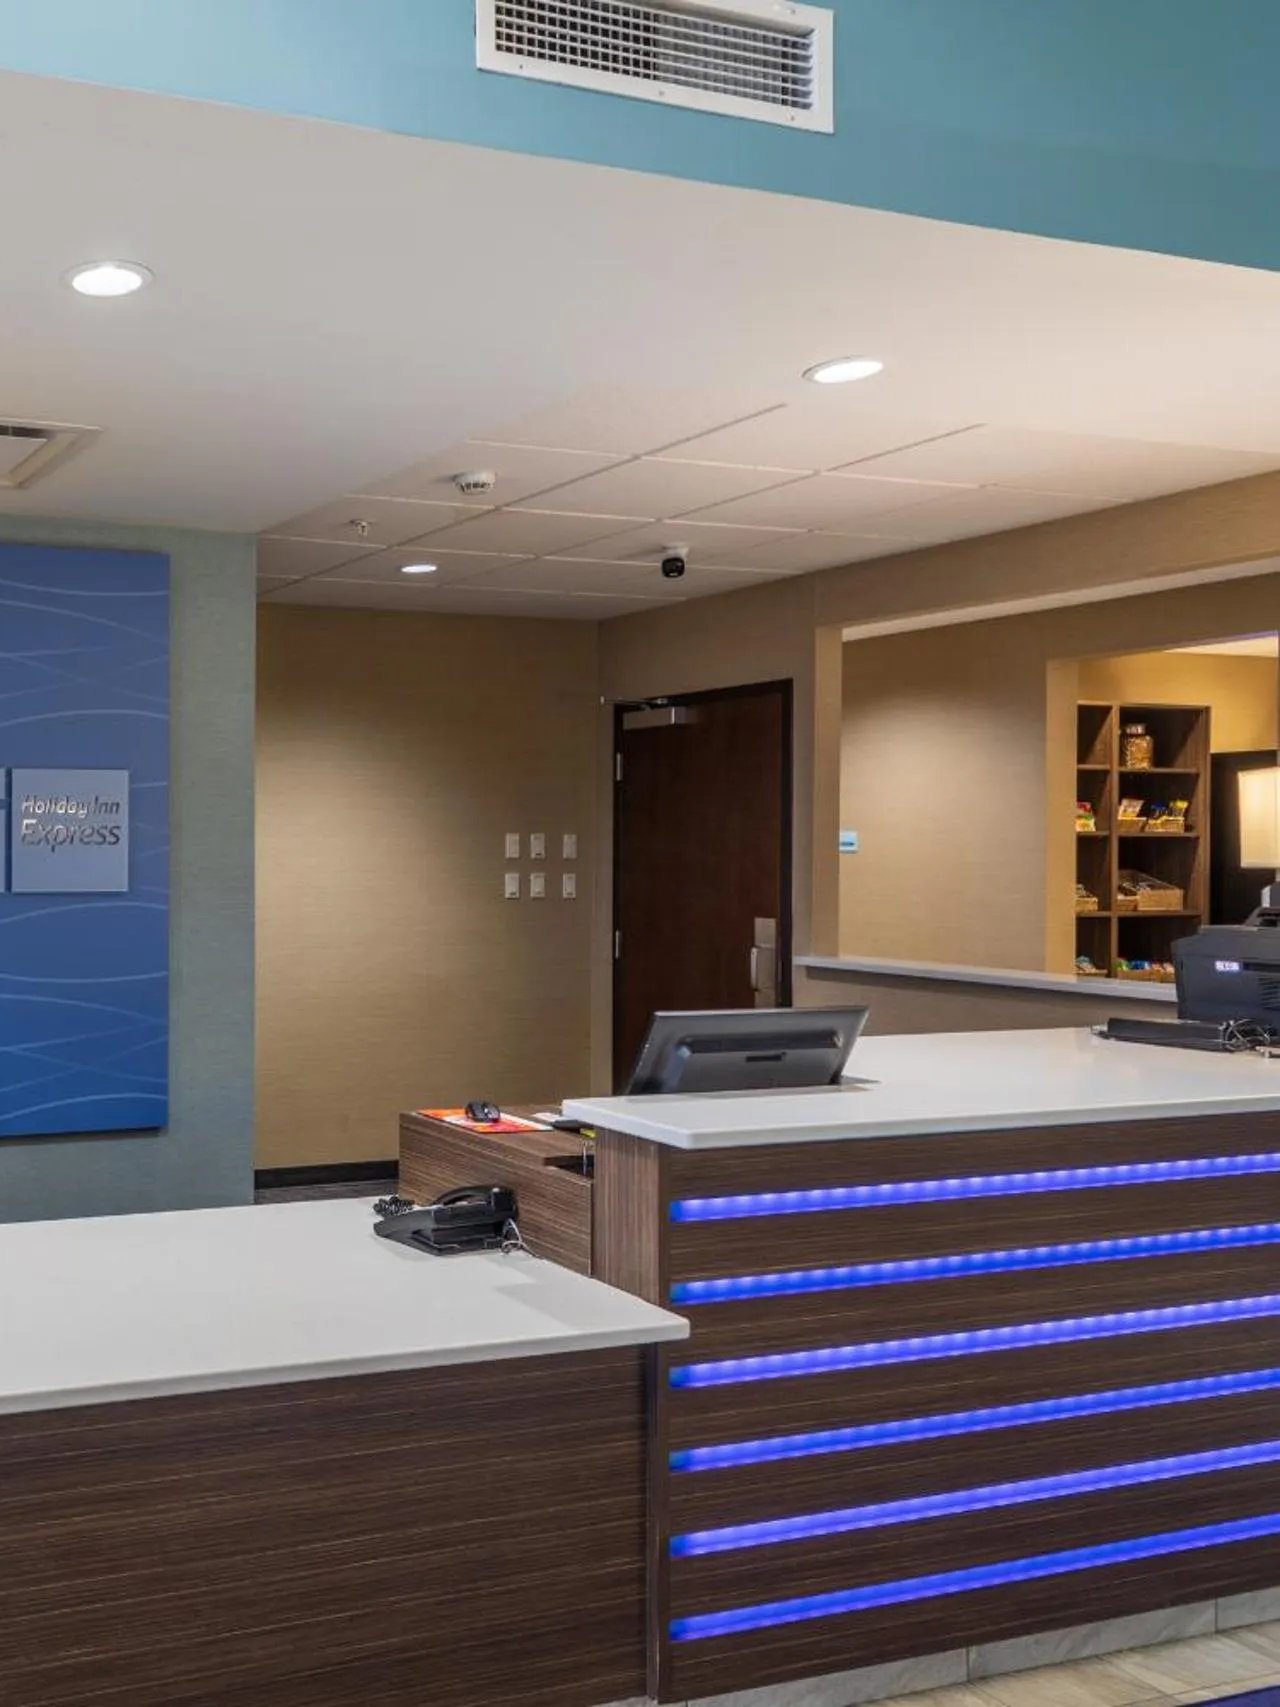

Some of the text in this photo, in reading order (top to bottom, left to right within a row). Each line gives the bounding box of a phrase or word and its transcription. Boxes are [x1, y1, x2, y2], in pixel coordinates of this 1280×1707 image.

[21, 795, 121, 819] Holiday Inn
[21, 818, 122, 853] Express
